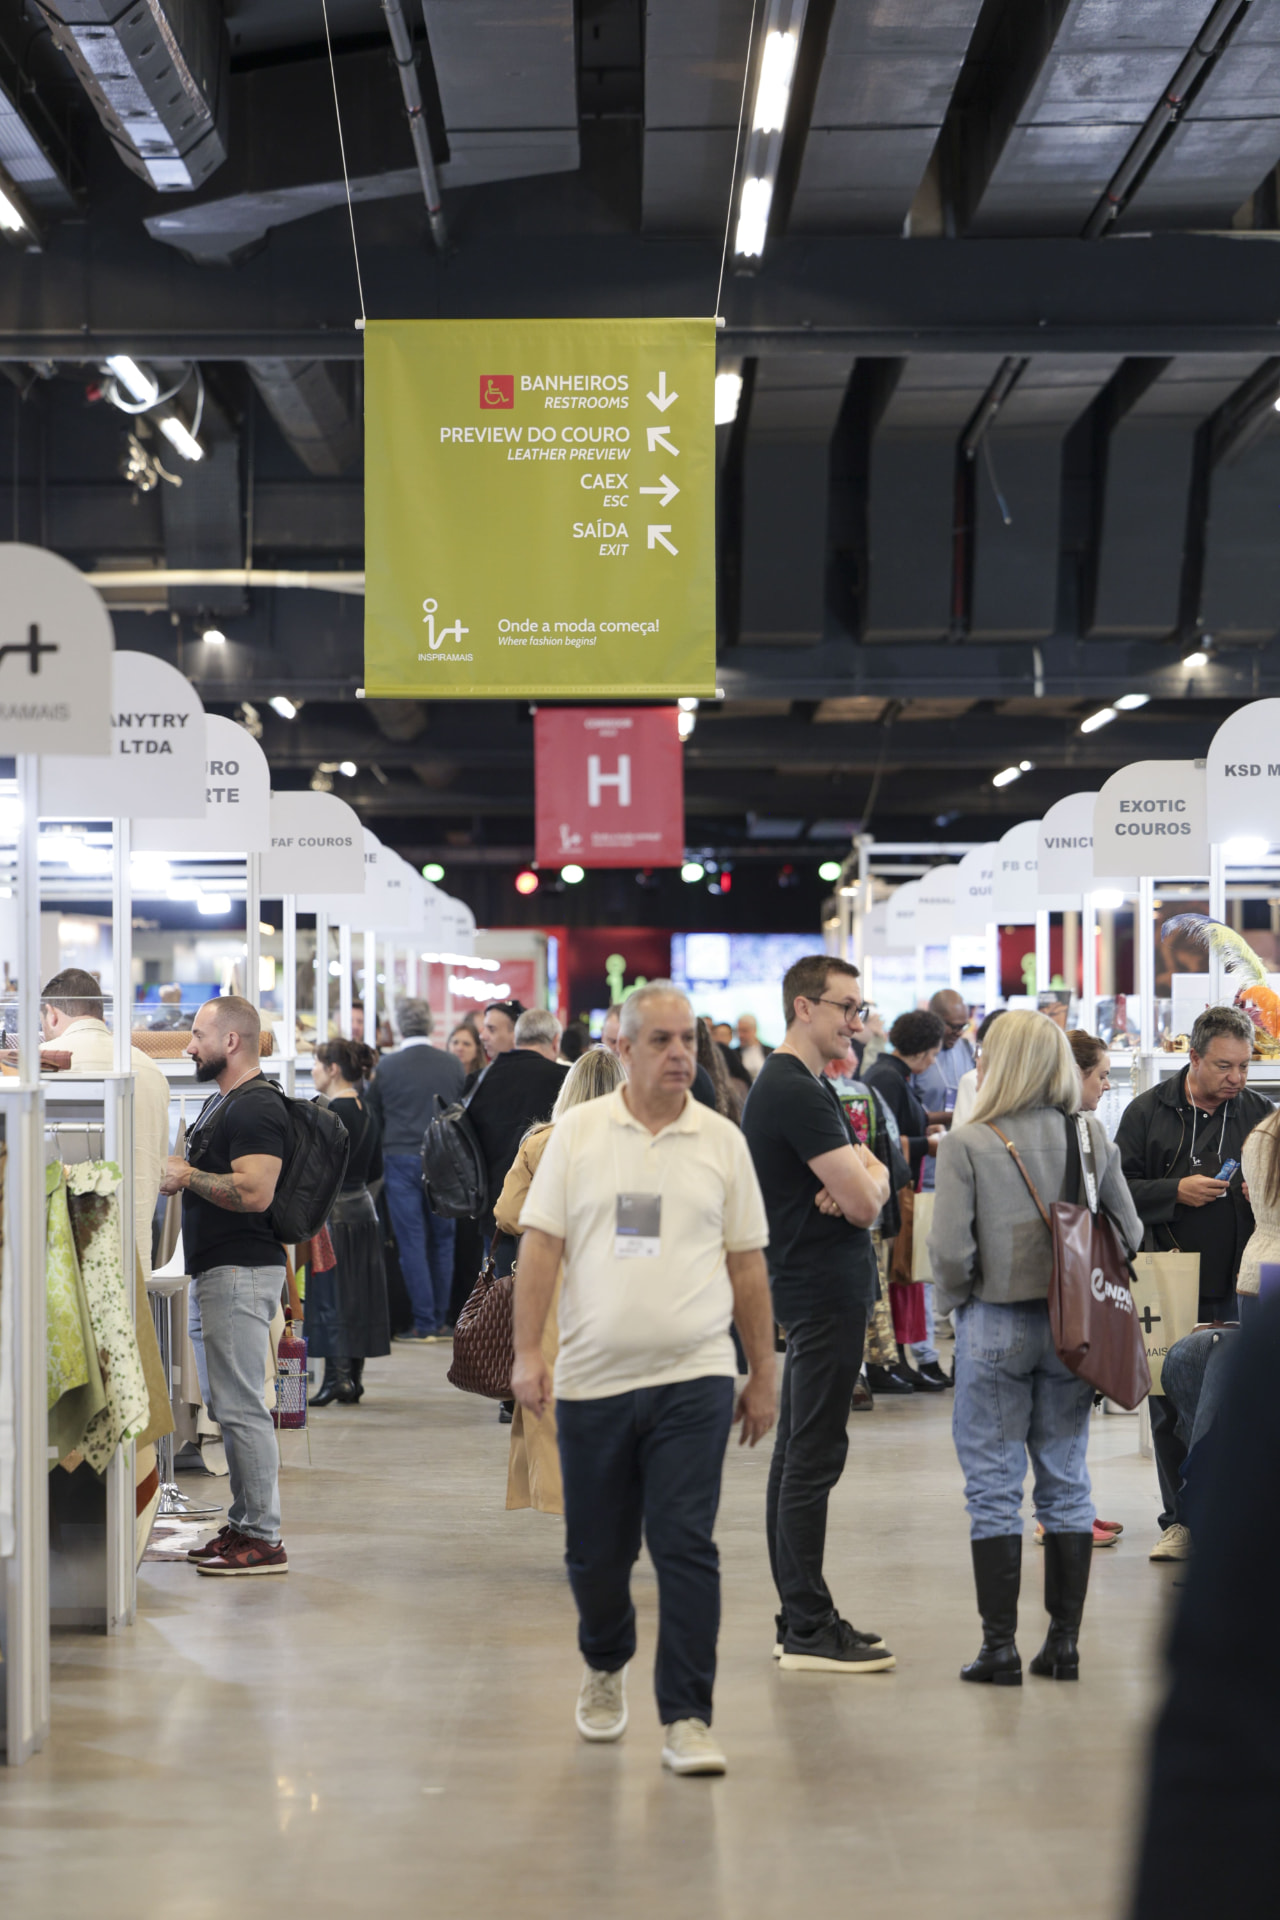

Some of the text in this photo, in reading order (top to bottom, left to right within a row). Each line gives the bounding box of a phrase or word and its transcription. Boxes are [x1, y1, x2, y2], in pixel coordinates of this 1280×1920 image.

[520, 374, 629, 391] BANHEIROS
[544, 396, 629, 409] RESTROOMS
[440, 427, 630, 443] PREVIEW DO COURO
[507, 448, 631, 461] LEATHER PREVIEW
[580, 473, 629, 490] CAEX
[603, 494, 630, 507] ESC
[572, 518, 629, 539] SAÍDA
[599, 543, 630, 556] EXIT
[498, 617, 660, 636] Onde a moda começa!
[498, 636, 597, 649] Where fashion begins!
[418, 653, 474, 662] INSPIRAMAIS
[120, 740, 173, 754] LTDA
[205, 760, 240, 776] RO
[1224, 764, 1262, 777] KSD
[587, 753, 631, 808] H
[1119, 800, 1187, 813] EXOTIC
[1115, 822, 1192, 836] COUROS
[271, 837, 353, 848] FAF COUROS
